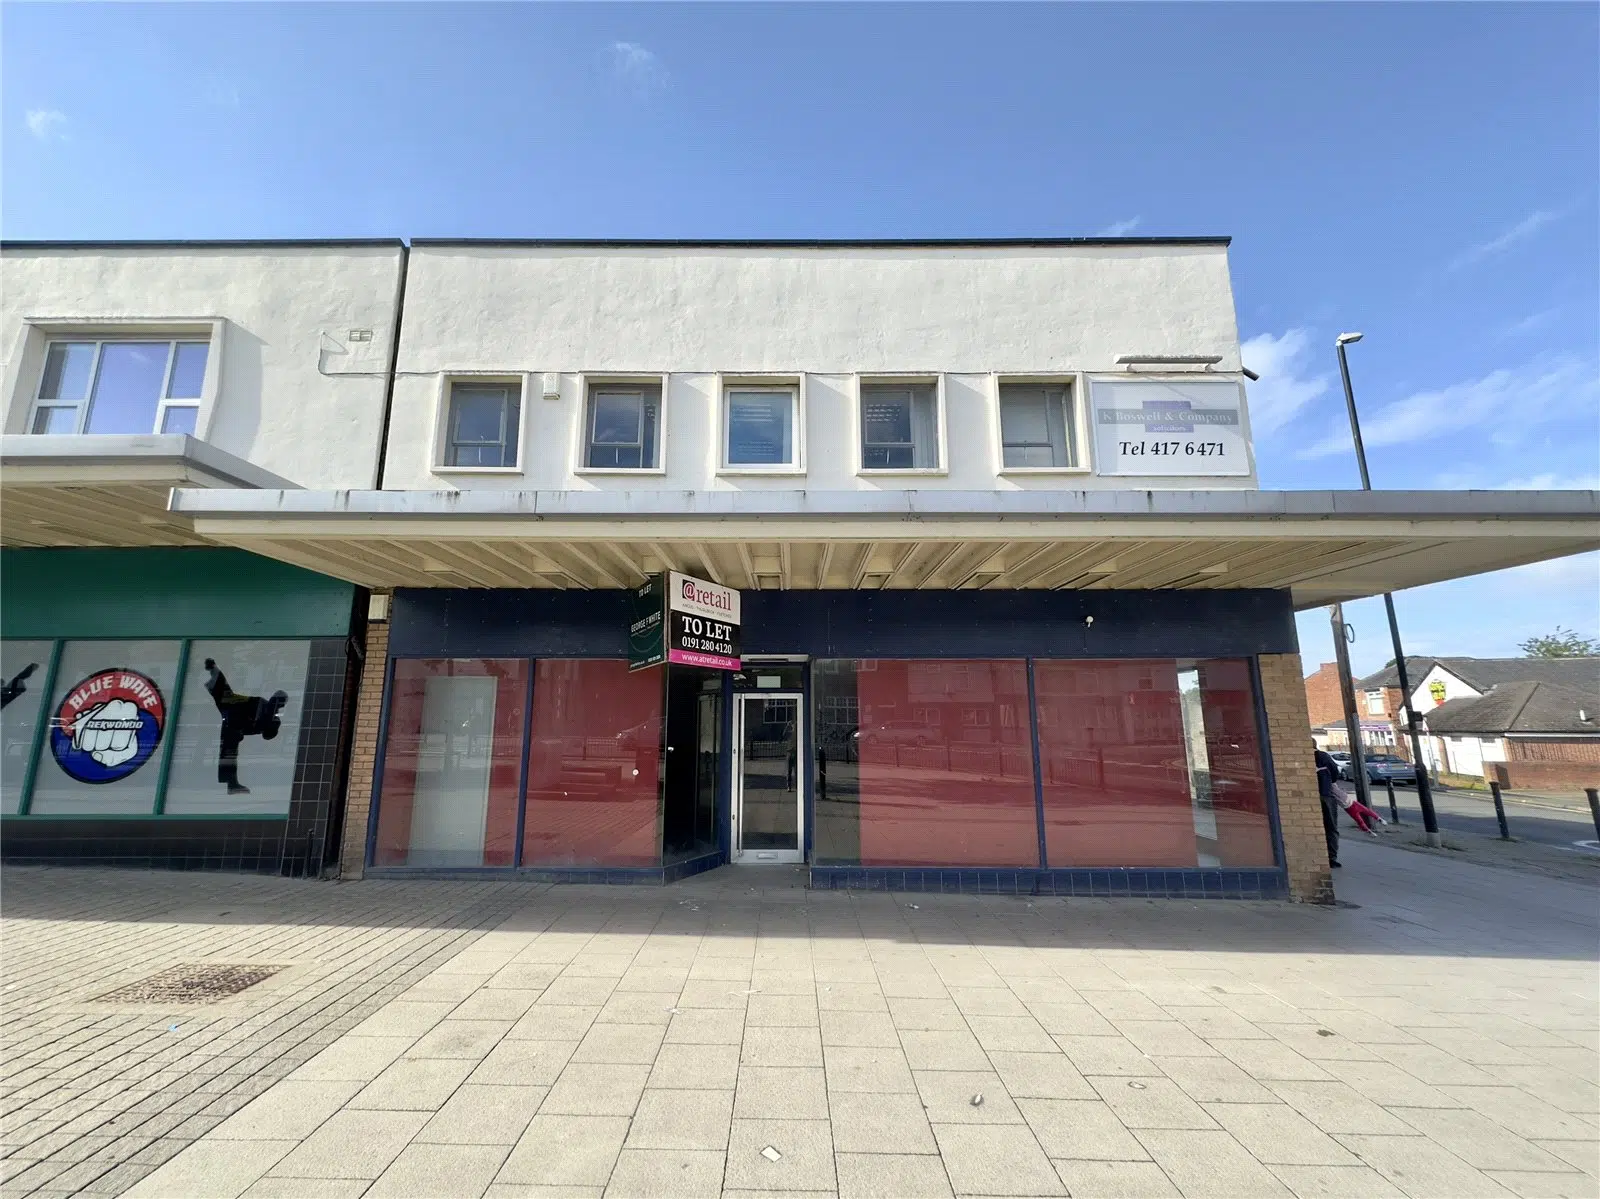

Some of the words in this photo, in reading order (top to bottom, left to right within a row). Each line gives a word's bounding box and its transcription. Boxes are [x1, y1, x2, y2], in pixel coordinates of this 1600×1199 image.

[1115, 411, 1160, 421] Boswell
[1164, 411, 1174, 421] &
[1178, 411, 1232, 424] Company
[1118, 441, 1146, 456] Tel
[1150, 441, 1180, 456] 417
[1185, 441, 1225, 456] 6471
[683, 581, 732, 611] @retail
[682, 615, 703, 635] TO
[705, 621, 732, 641] LET
[682, 636, 699, 649] 0191
[700, 639, 715, 651] 280
[715, 642, 733, 654] 4120
[682, 654, 732, 666] www.atretail.co.uk
[69, 675, 114, 710] BLUE
[118, 675, 158, 708] WAVE
